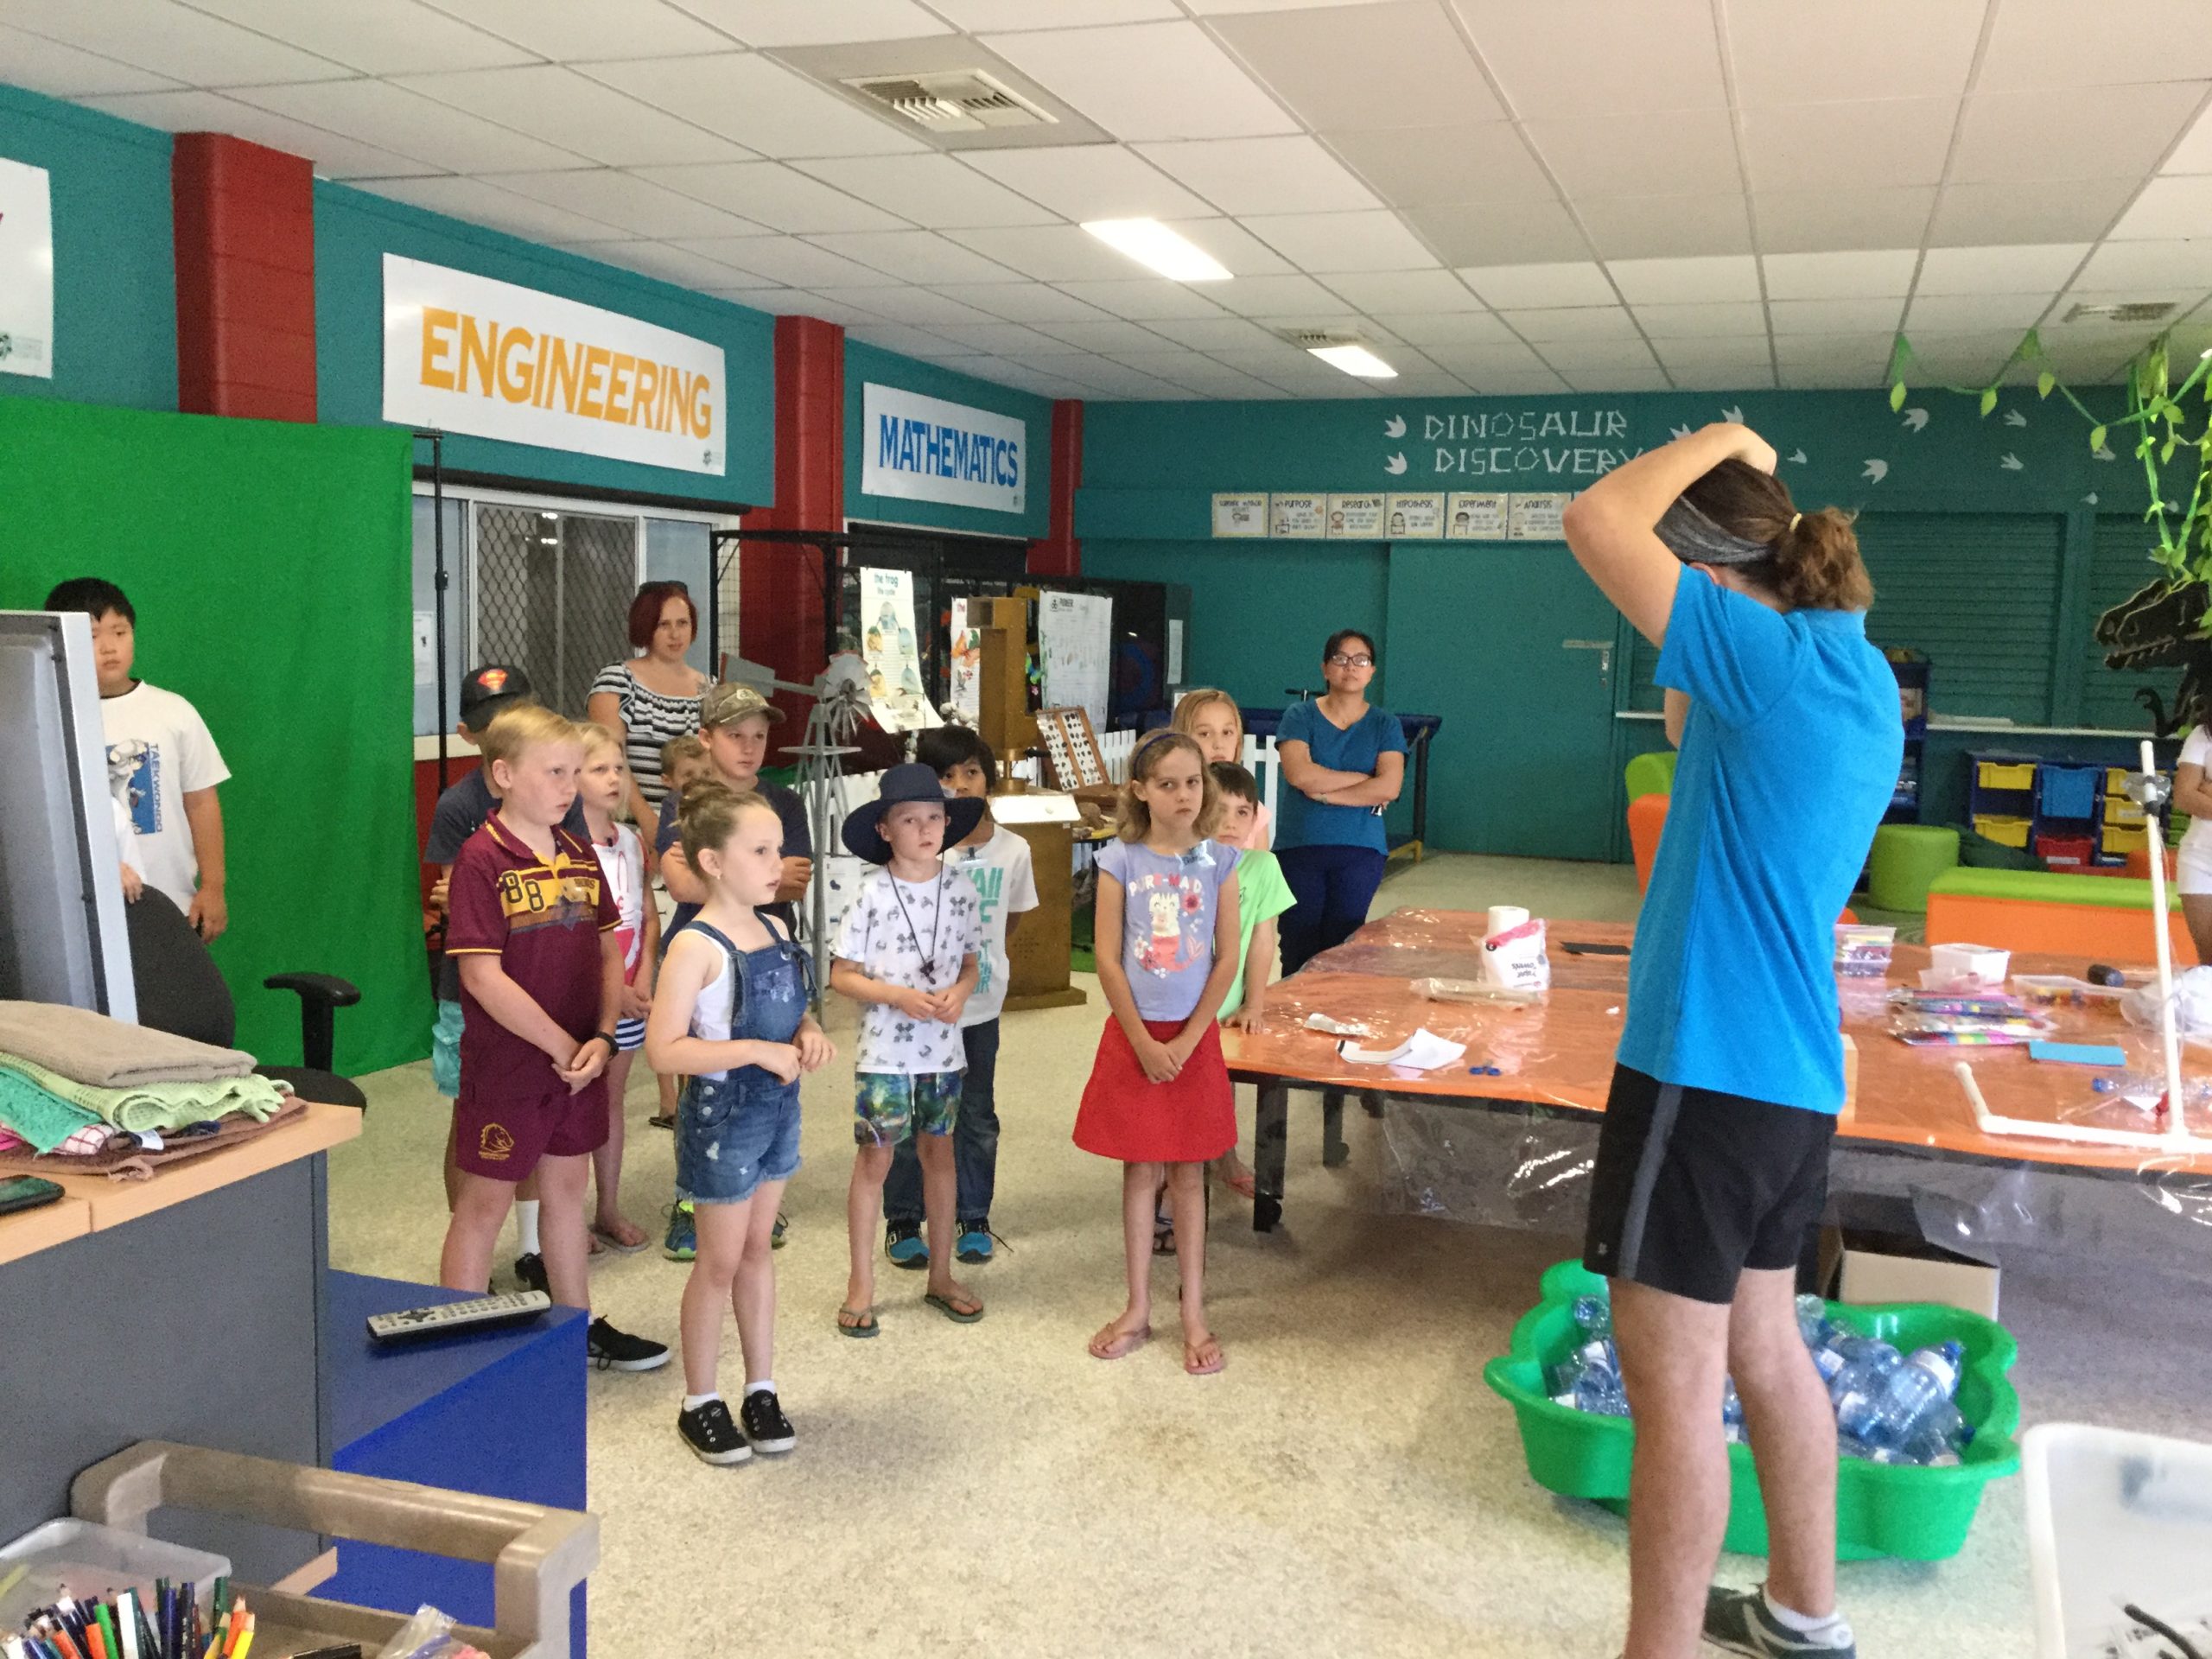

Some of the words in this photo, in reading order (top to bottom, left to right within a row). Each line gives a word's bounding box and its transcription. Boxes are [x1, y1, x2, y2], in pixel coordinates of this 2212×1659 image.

[419, 305, 712, 441] ENGINEERING
[879, 414, 1018, 488] MATHEMATICS
[1425, 410, 1627, 440] DINOSAUR
[149, 743, 162, 833] TAEKWONDO
